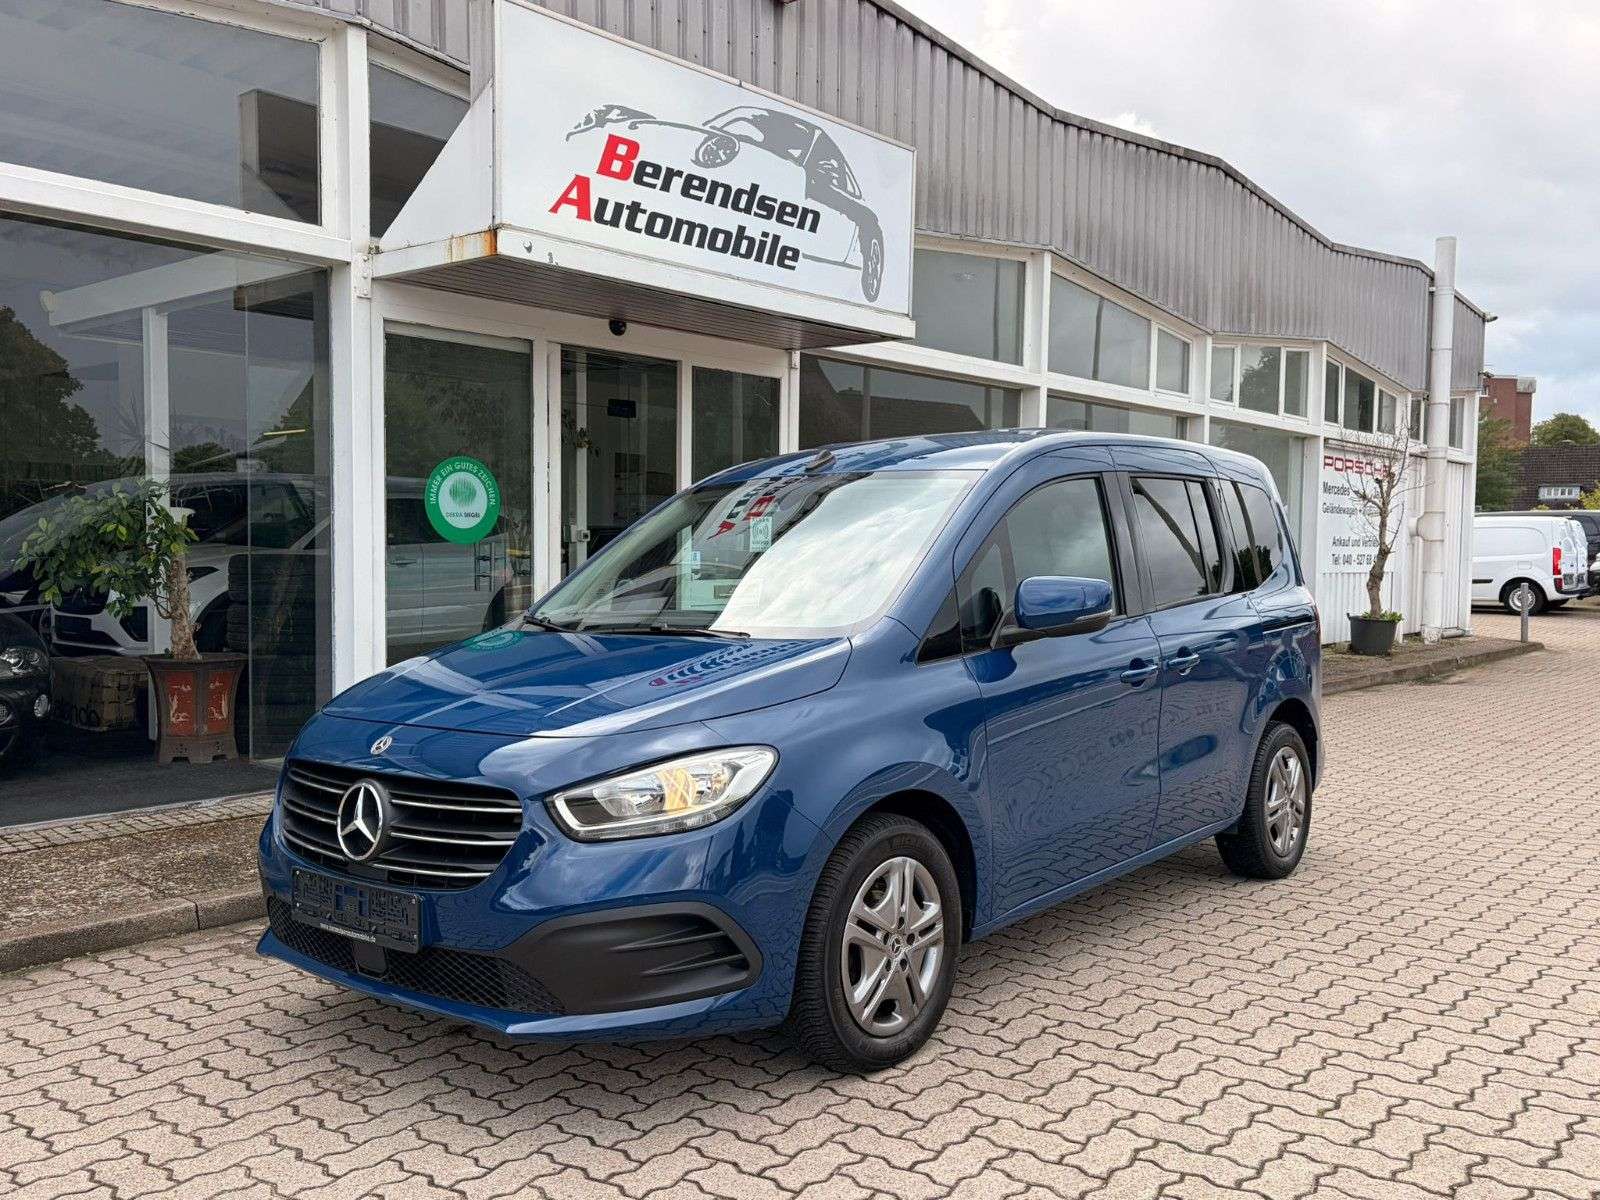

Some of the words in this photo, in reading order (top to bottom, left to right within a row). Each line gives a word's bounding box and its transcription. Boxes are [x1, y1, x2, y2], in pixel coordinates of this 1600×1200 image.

[596, 133, 821, 233] Berendsen
[549, 174, 801, 271] Automobile
[430, 475, 442, 504] IMMER
[440, 464, 454, 477] EIN
[478, 469, 497, 506] ZEICHEN
[1322, 481, 1351, 496] Mercedes
